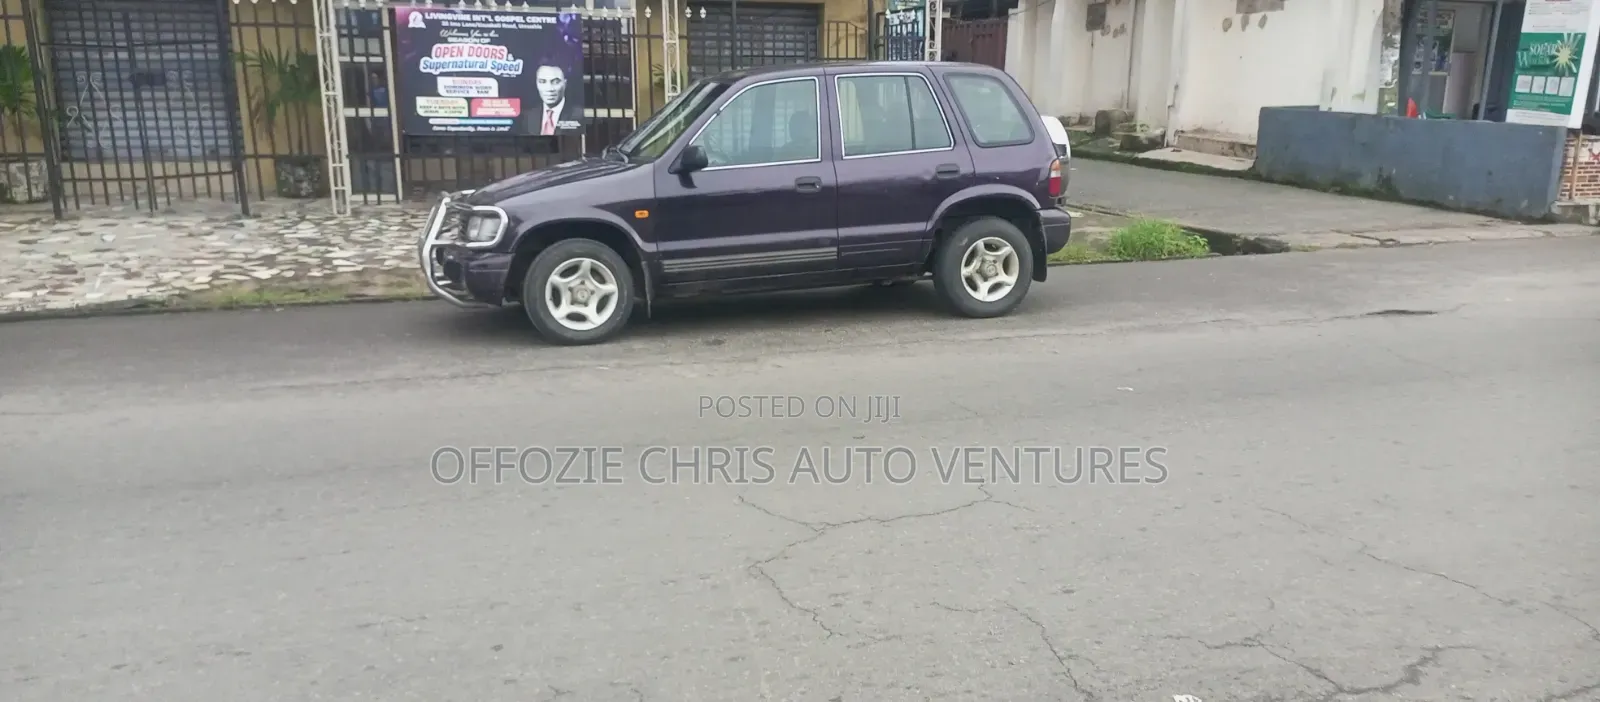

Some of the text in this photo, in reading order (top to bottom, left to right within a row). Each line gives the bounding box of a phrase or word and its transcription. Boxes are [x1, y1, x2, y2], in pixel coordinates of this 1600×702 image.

[425, 12, 471, 21] LIVINGVINE
[494, 15, 525, 23] GOSPEL
[526, 16, 557, 24] CENTRE
[434, 46, 464, 58] OPEN
[468, 46, 505, 60] DOORS
[422, 60, 521, 72] Supernatural Speed
